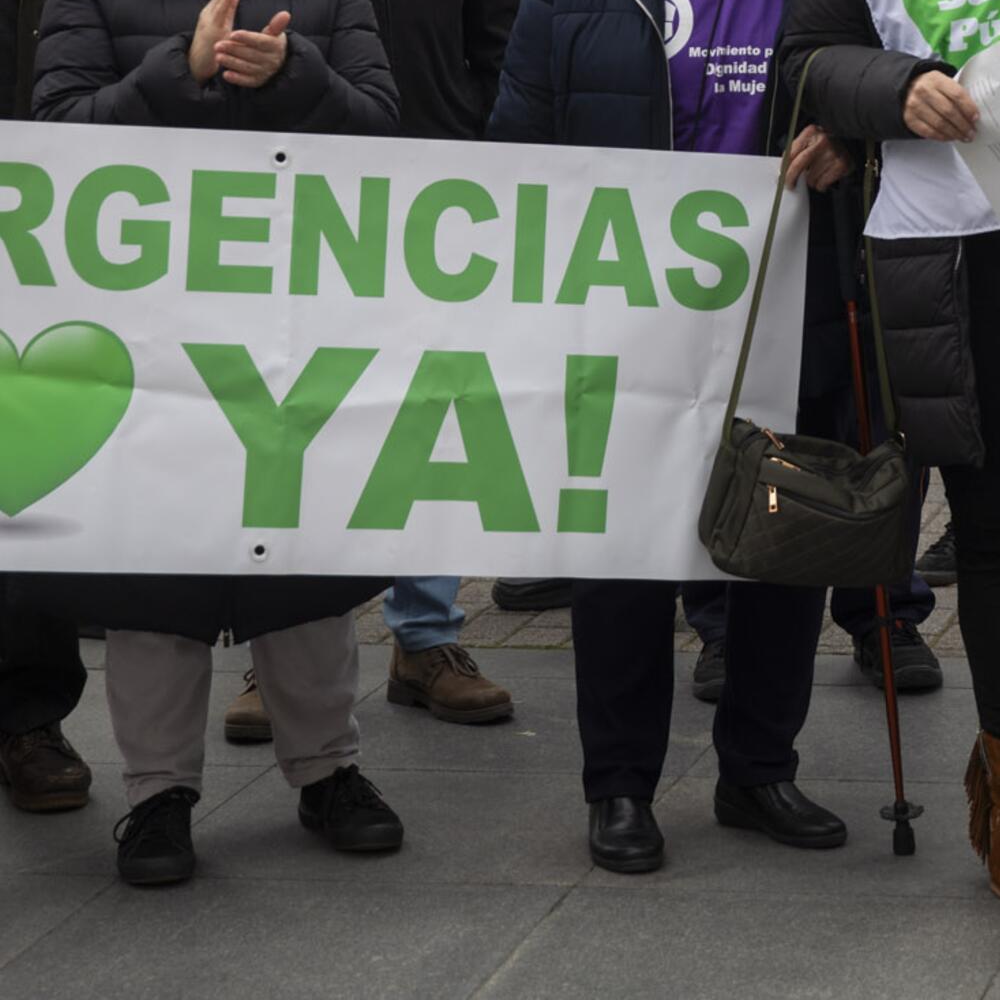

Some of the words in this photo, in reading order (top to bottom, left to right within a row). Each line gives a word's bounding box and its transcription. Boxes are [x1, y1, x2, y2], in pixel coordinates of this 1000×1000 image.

[688, 45, 761, 58] Movmiento
[0, 162, 750, 312] RGENCIAS
[180, 342, 620, 534] YA!
